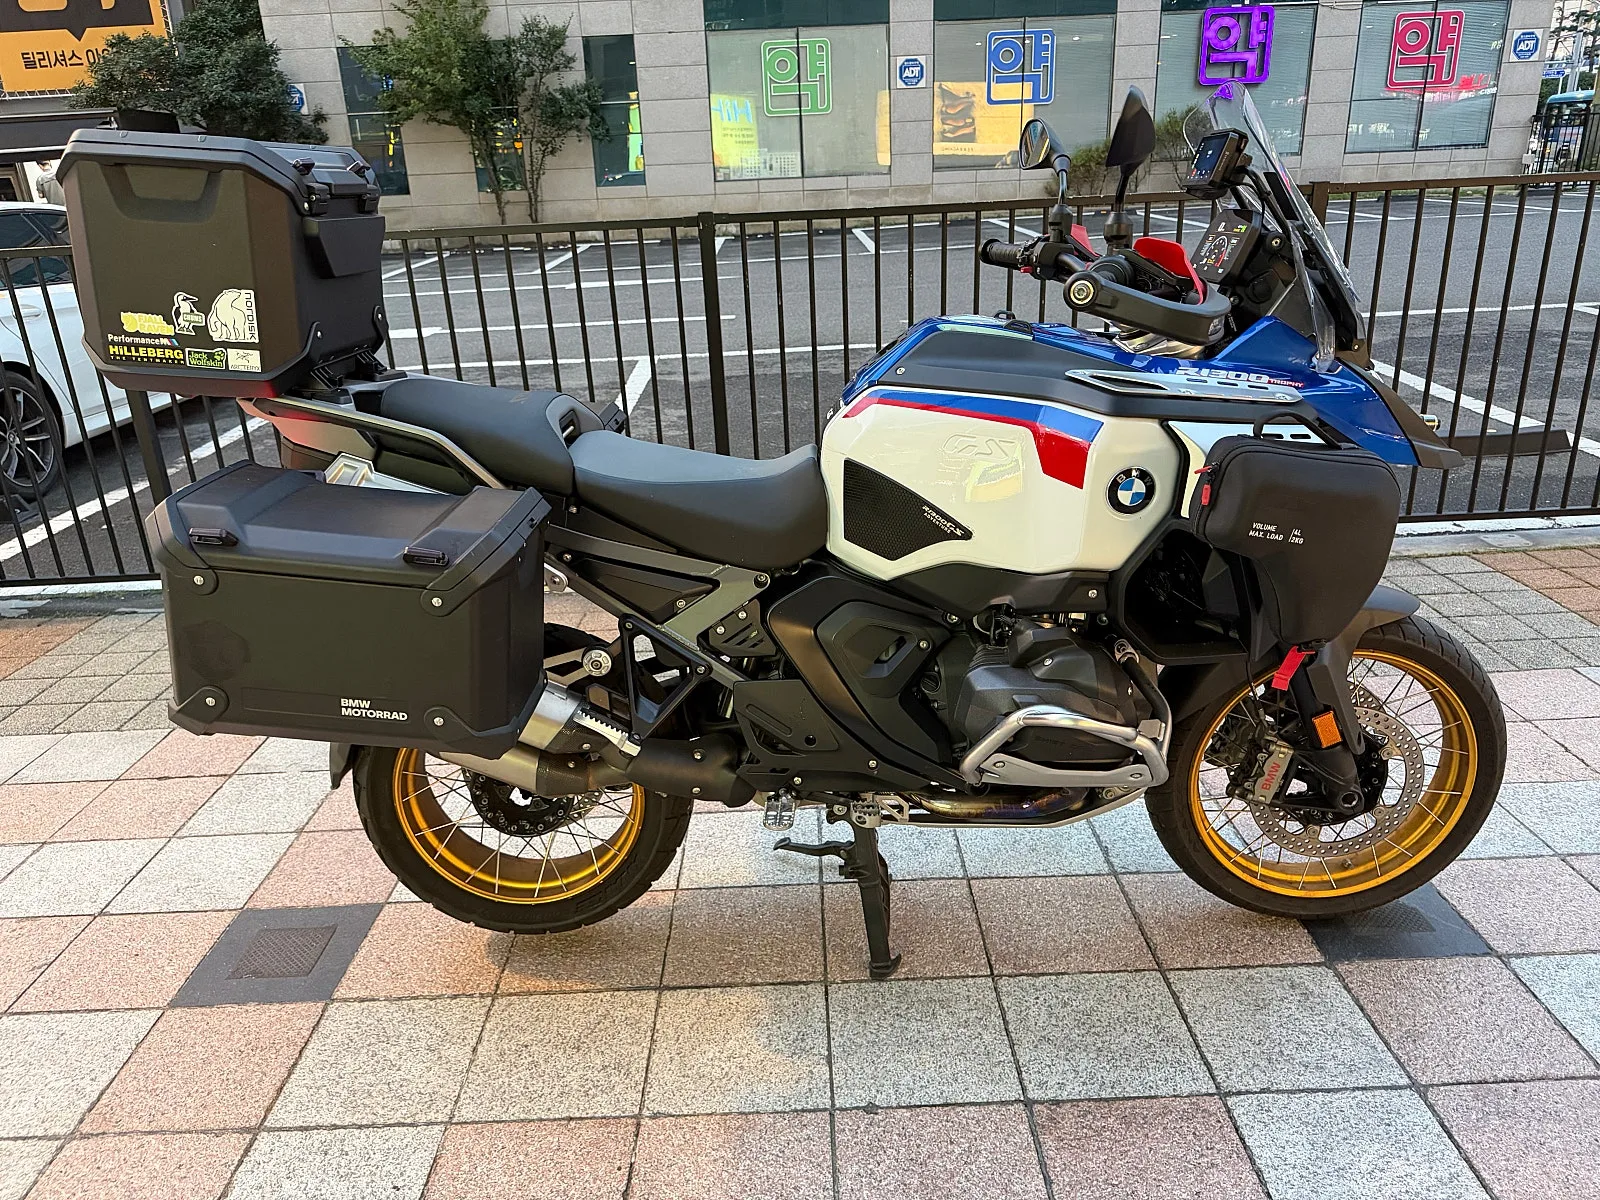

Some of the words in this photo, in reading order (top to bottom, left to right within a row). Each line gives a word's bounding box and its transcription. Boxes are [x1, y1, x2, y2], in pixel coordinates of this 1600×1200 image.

[1200, 5, 1275, 85] 약
[1387, 10, 1465, 89] 약
[1518, 40, 1535, 51] ADT
[20, 50, 83, 70] 딜리셔스
[902, 66, 920, 78] ADT
[986, 29, 1056, 105] 약
[761, 38, 831, 116] 약
[189, 352, 208, 360] Jack
[189, 357, 223, 368] Wolfskin
[1267, 378, 1304, 388] TROPHY
[1252, 522, 1278, 532] VOLUME
[1266, 532, 1284, 541] LOAD
[340, 698, 371, 709] BMW
[341, 707, 408, 721] MOTORRAD
[1262, 762, 1281, 790] BMW
